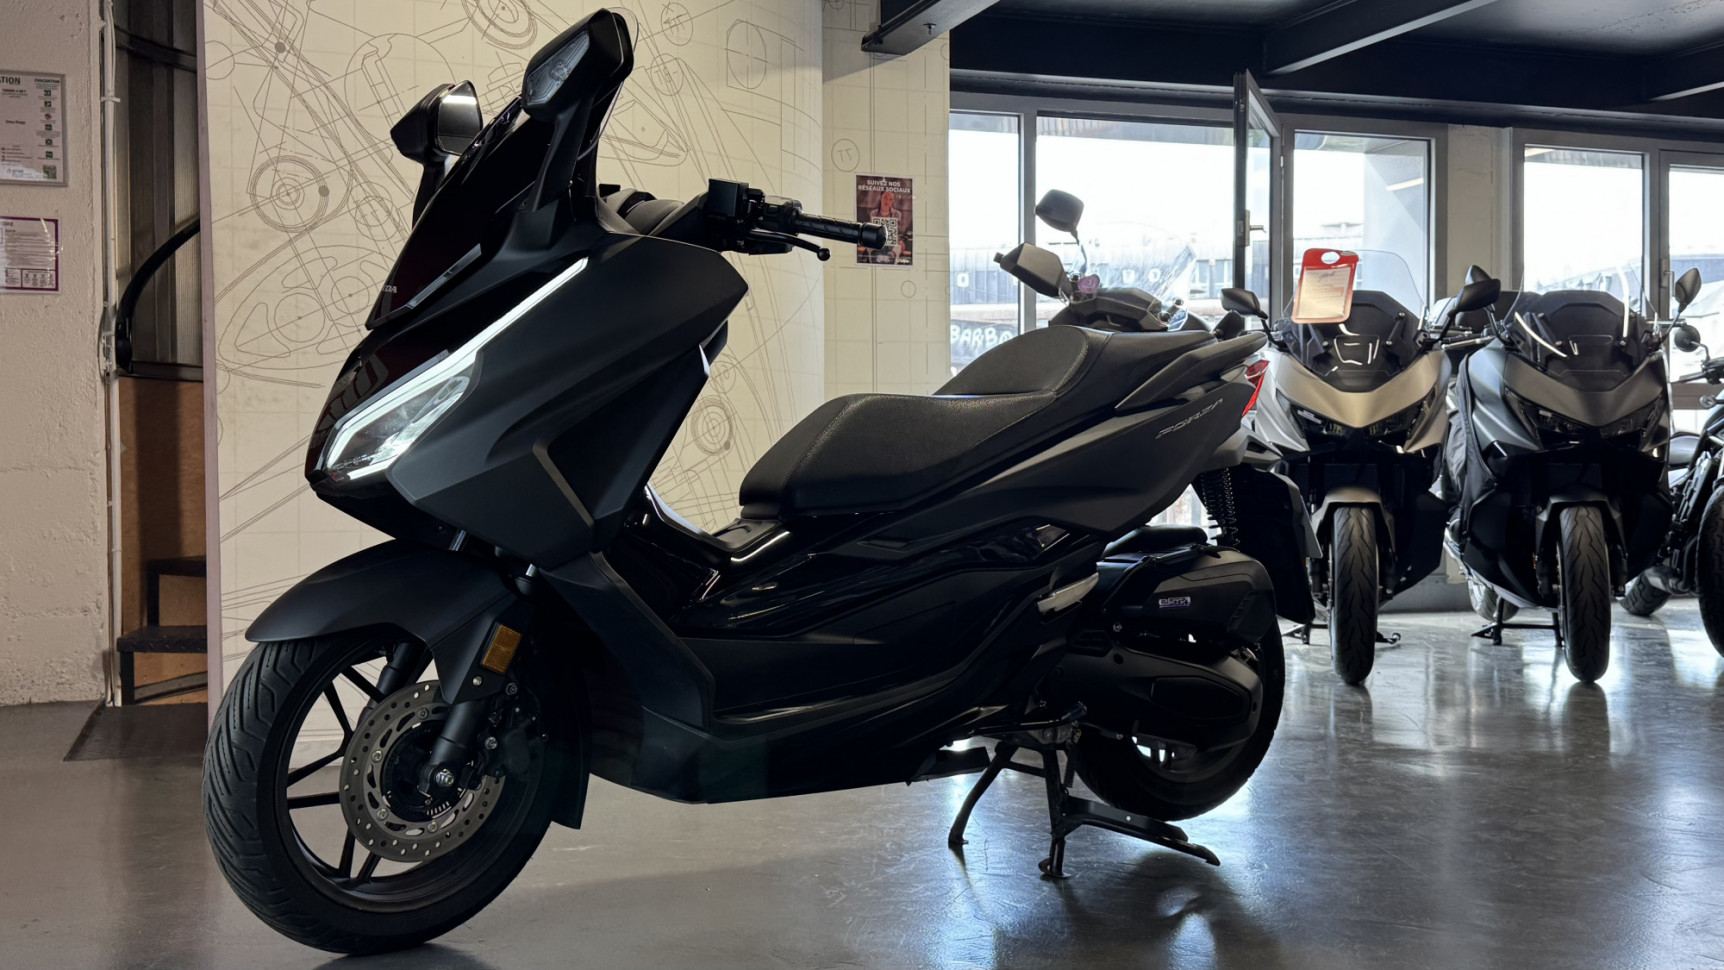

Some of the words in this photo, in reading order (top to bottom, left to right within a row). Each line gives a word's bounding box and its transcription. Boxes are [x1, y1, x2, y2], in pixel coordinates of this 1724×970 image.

[0, 76, 21, 85] TION
[866, 179, 888, 187] SUIVEZ
[857, 184, 885, 192] RÉSEAUX
[885, 186, 911, 194] SOCIAUX
[1154, 398, 1223, 440] FORZA
